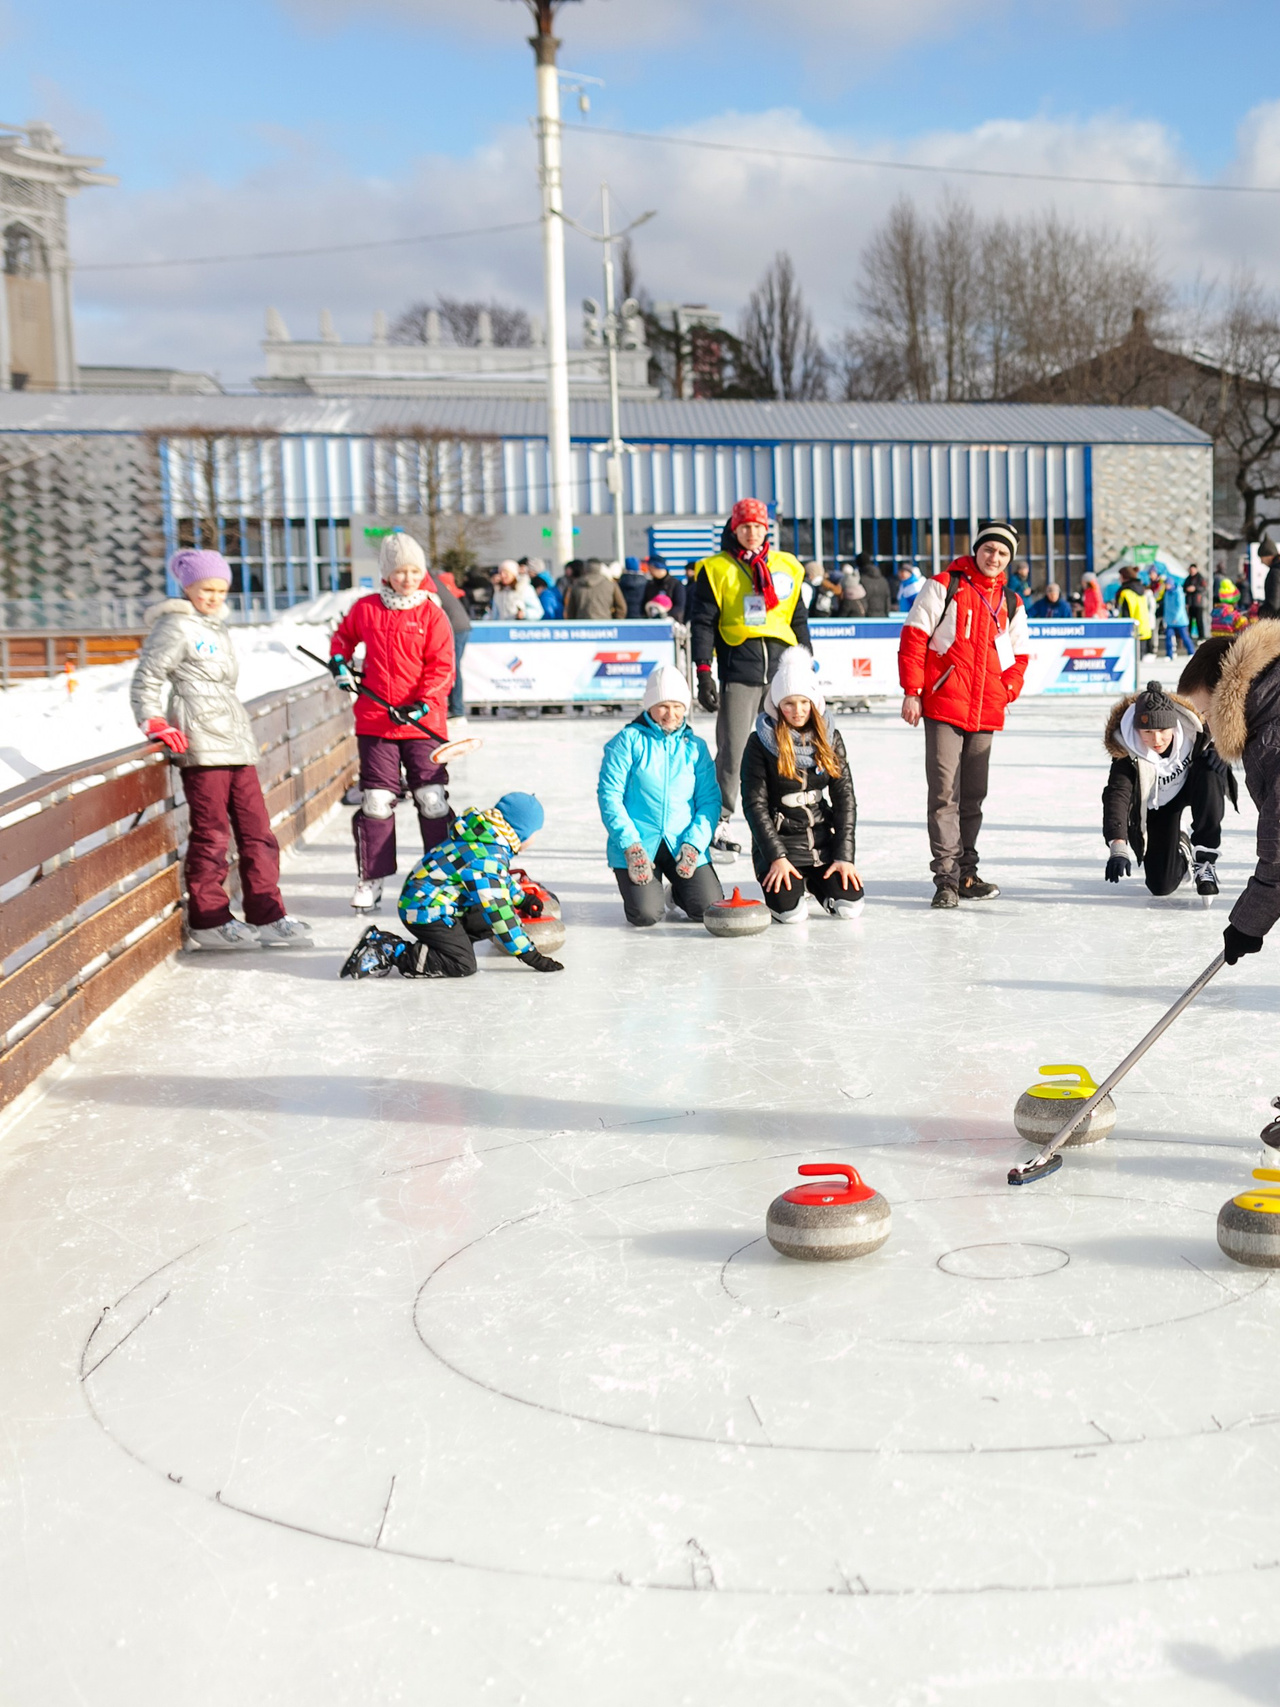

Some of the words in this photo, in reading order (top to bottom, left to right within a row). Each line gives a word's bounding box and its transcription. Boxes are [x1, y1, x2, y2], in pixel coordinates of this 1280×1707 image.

[509, 628, 551, 640] Болей
[552, 630, 569, 640] за
[570, 628, 618, 640] наших!
[1041, 625, 1085, 636] наших!
